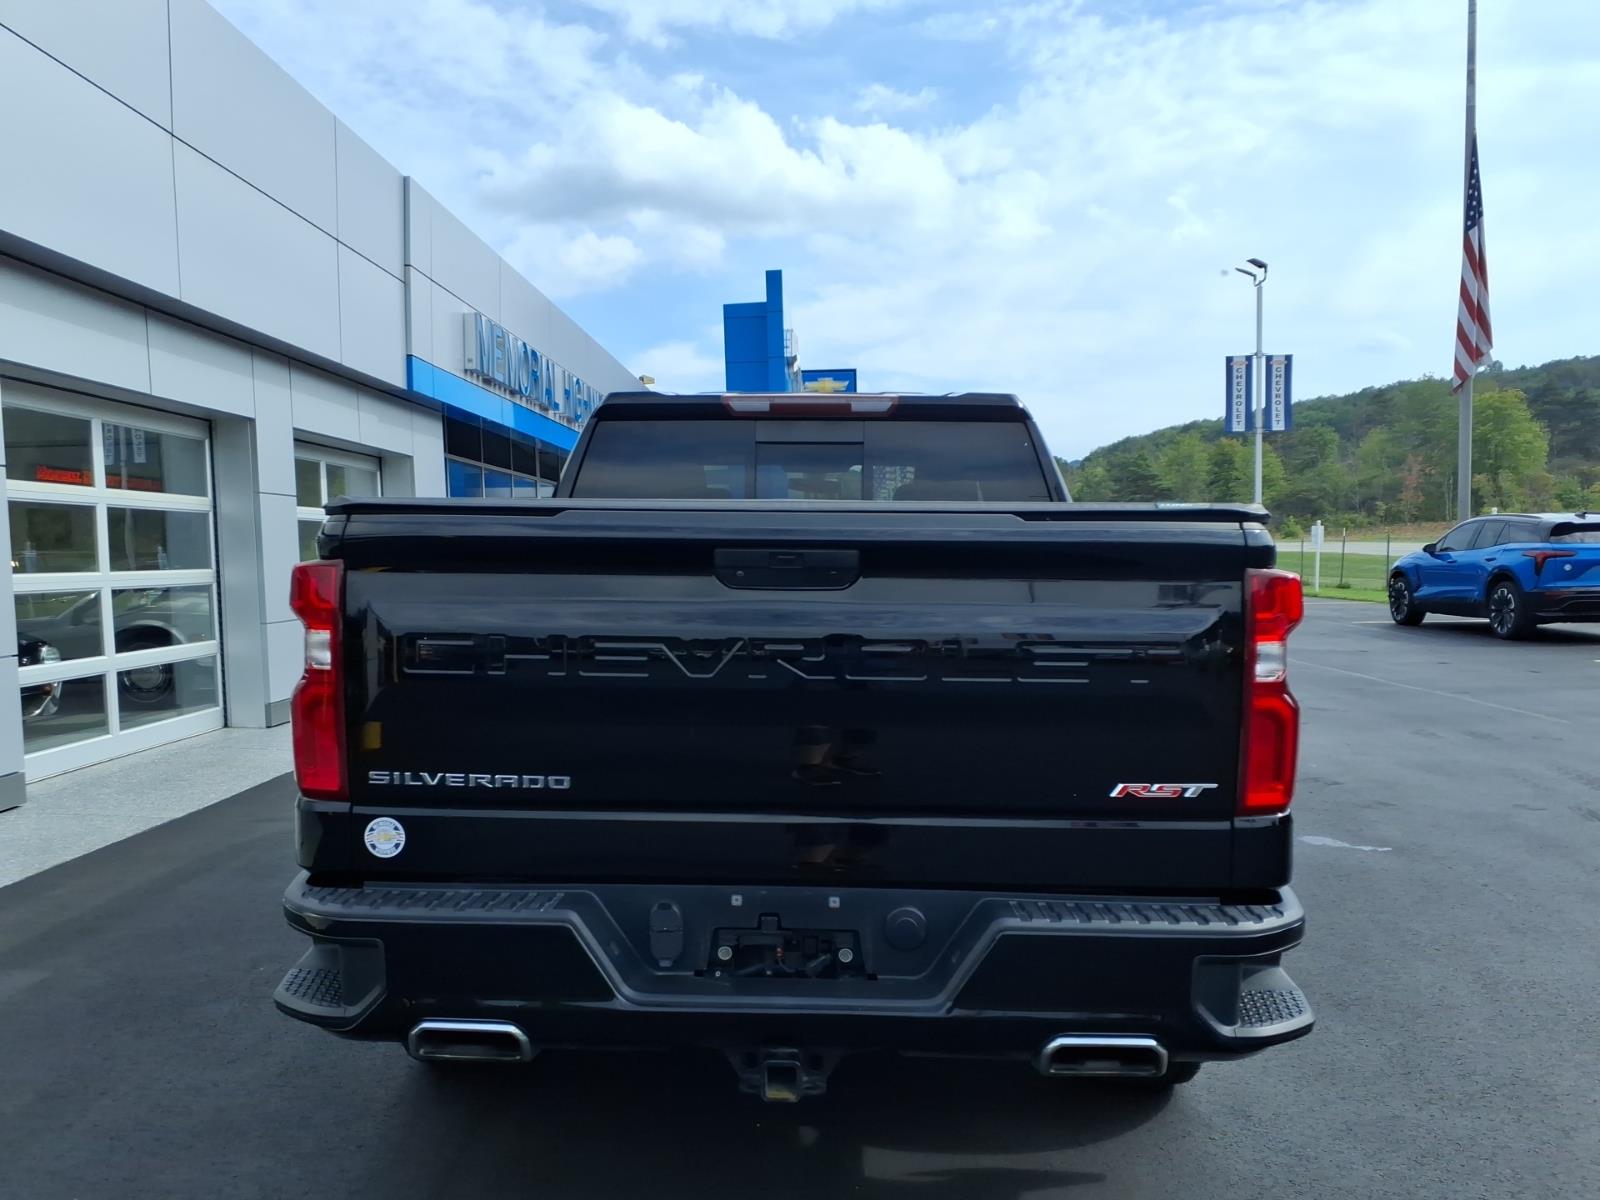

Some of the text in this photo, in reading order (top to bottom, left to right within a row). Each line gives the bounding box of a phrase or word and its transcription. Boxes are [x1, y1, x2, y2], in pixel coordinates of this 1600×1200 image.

[465, 312, 560, 411] MEMORIAL
[367, 770, 571, 790] SILVERADO
[1109, 782, 1219, 798] RST
